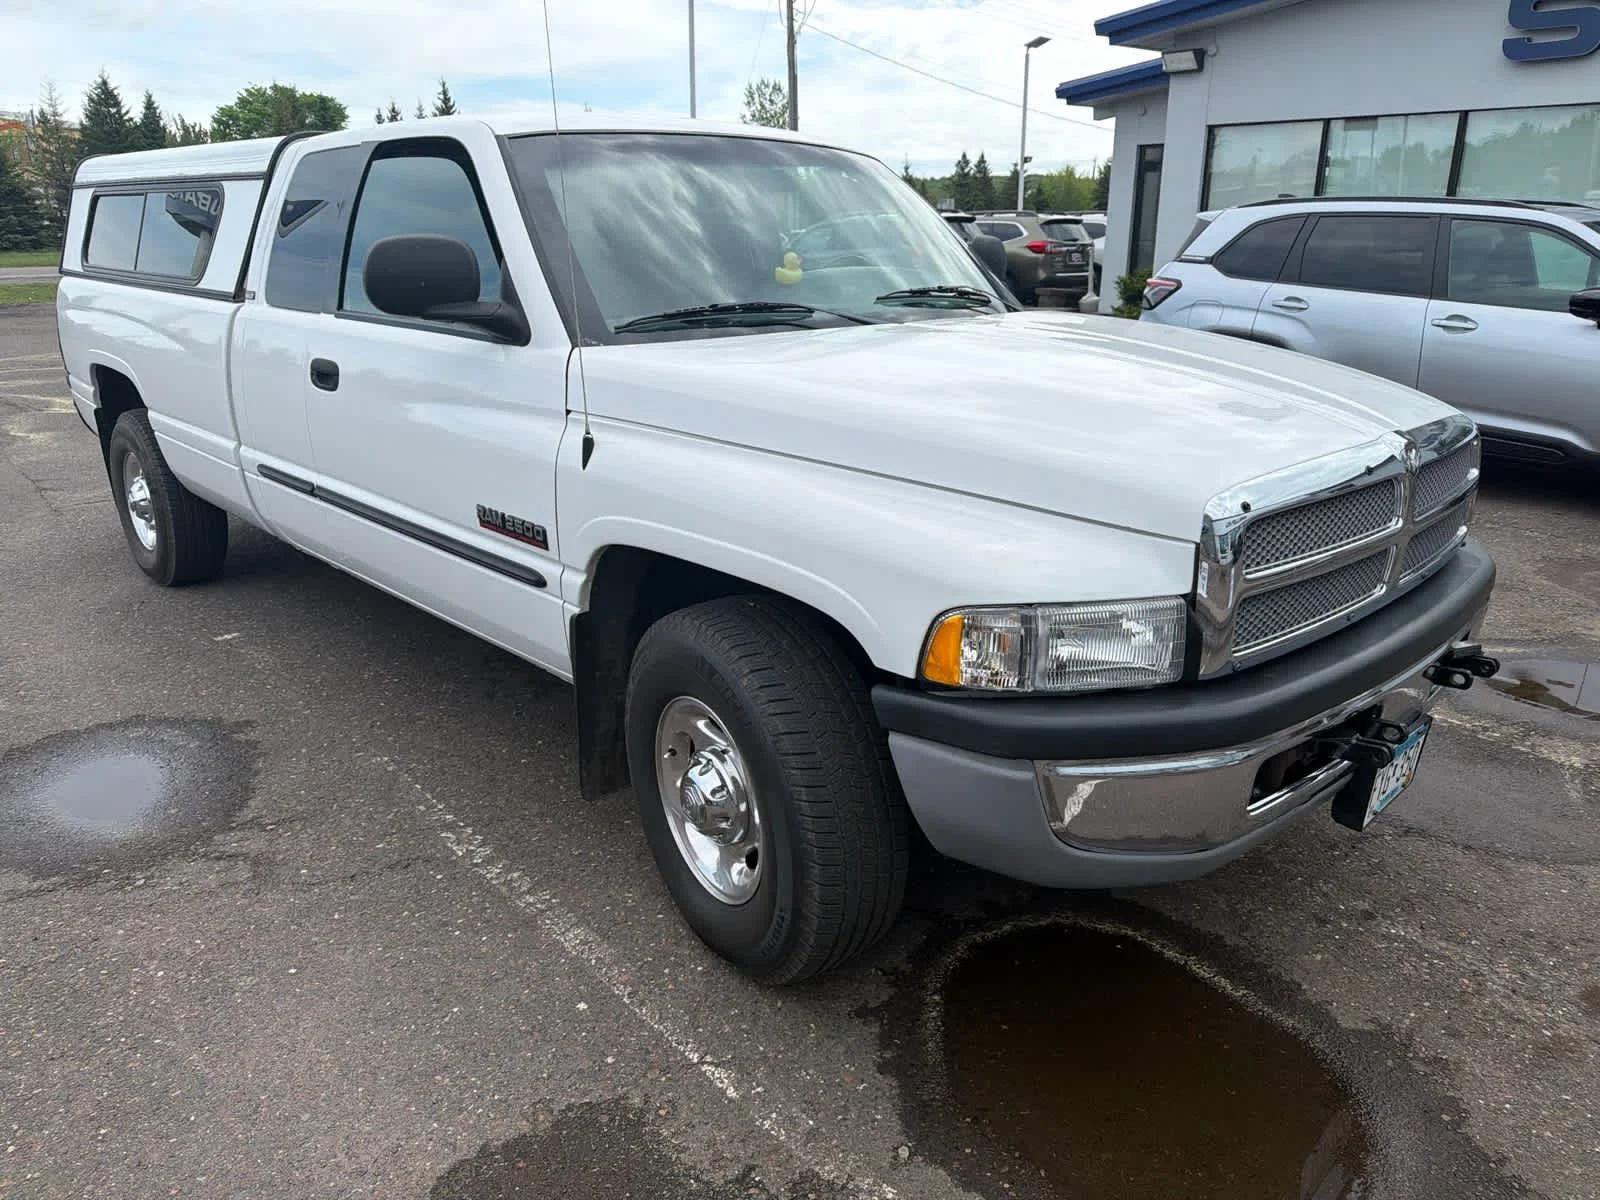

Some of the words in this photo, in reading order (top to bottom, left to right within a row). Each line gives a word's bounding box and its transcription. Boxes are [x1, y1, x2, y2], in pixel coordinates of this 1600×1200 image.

[1503, 0, 1600, 61] S
[476, 503, 506, 530] RAM
[505, 514, 547, 543] 2500
